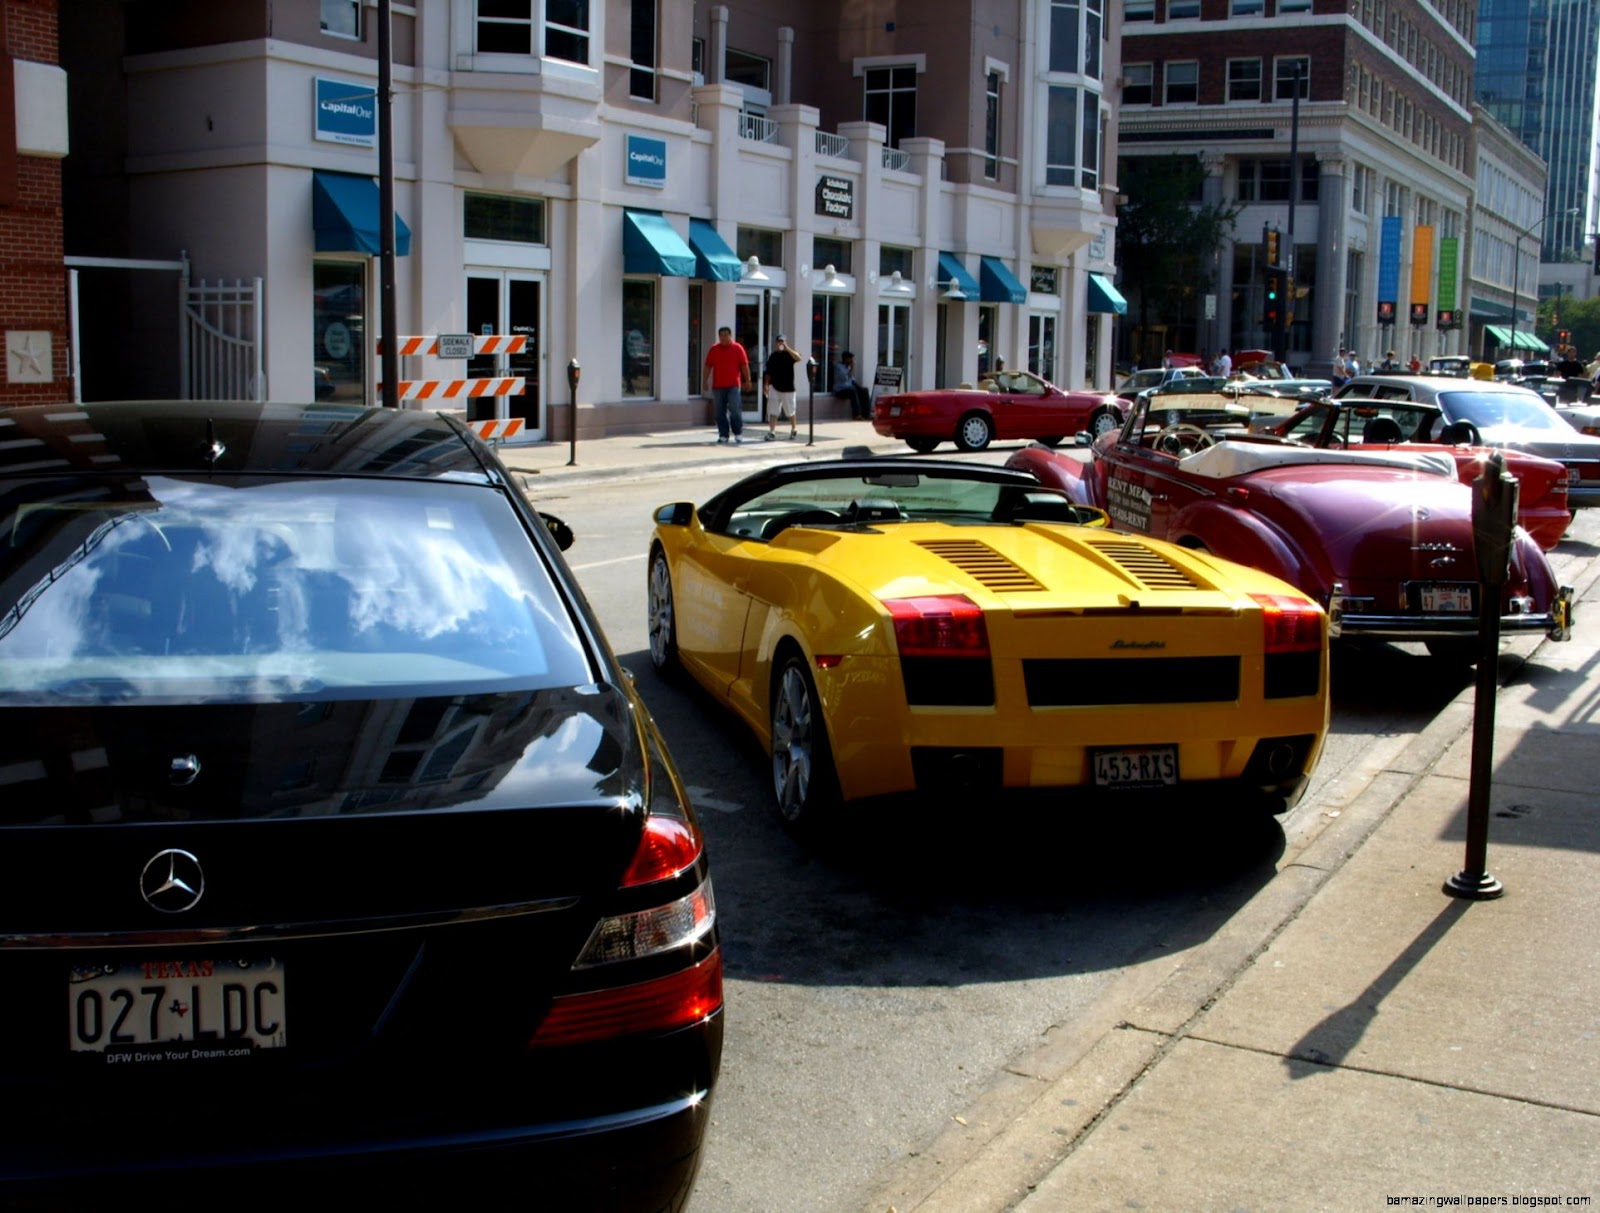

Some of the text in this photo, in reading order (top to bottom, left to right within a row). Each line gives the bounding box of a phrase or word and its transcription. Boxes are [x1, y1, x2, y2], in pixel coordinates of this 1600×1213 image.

[822, 187, 852, 203] Chocolate
[825, 200, 848, 217] Factory
[442, 338, 470, 347] SIDEWALK
[445, 346, 467, 356] CLOSED
[1107, 476, 1128, 494] RENT
[1097, 754, 1174, 782] 453 RXS
[142, 959, 215, 980] TEXAS
[76, 981, 280, 1044] 027 LDC
[106, 1047, 251, 1064] DFW Drive Your Dream.com
